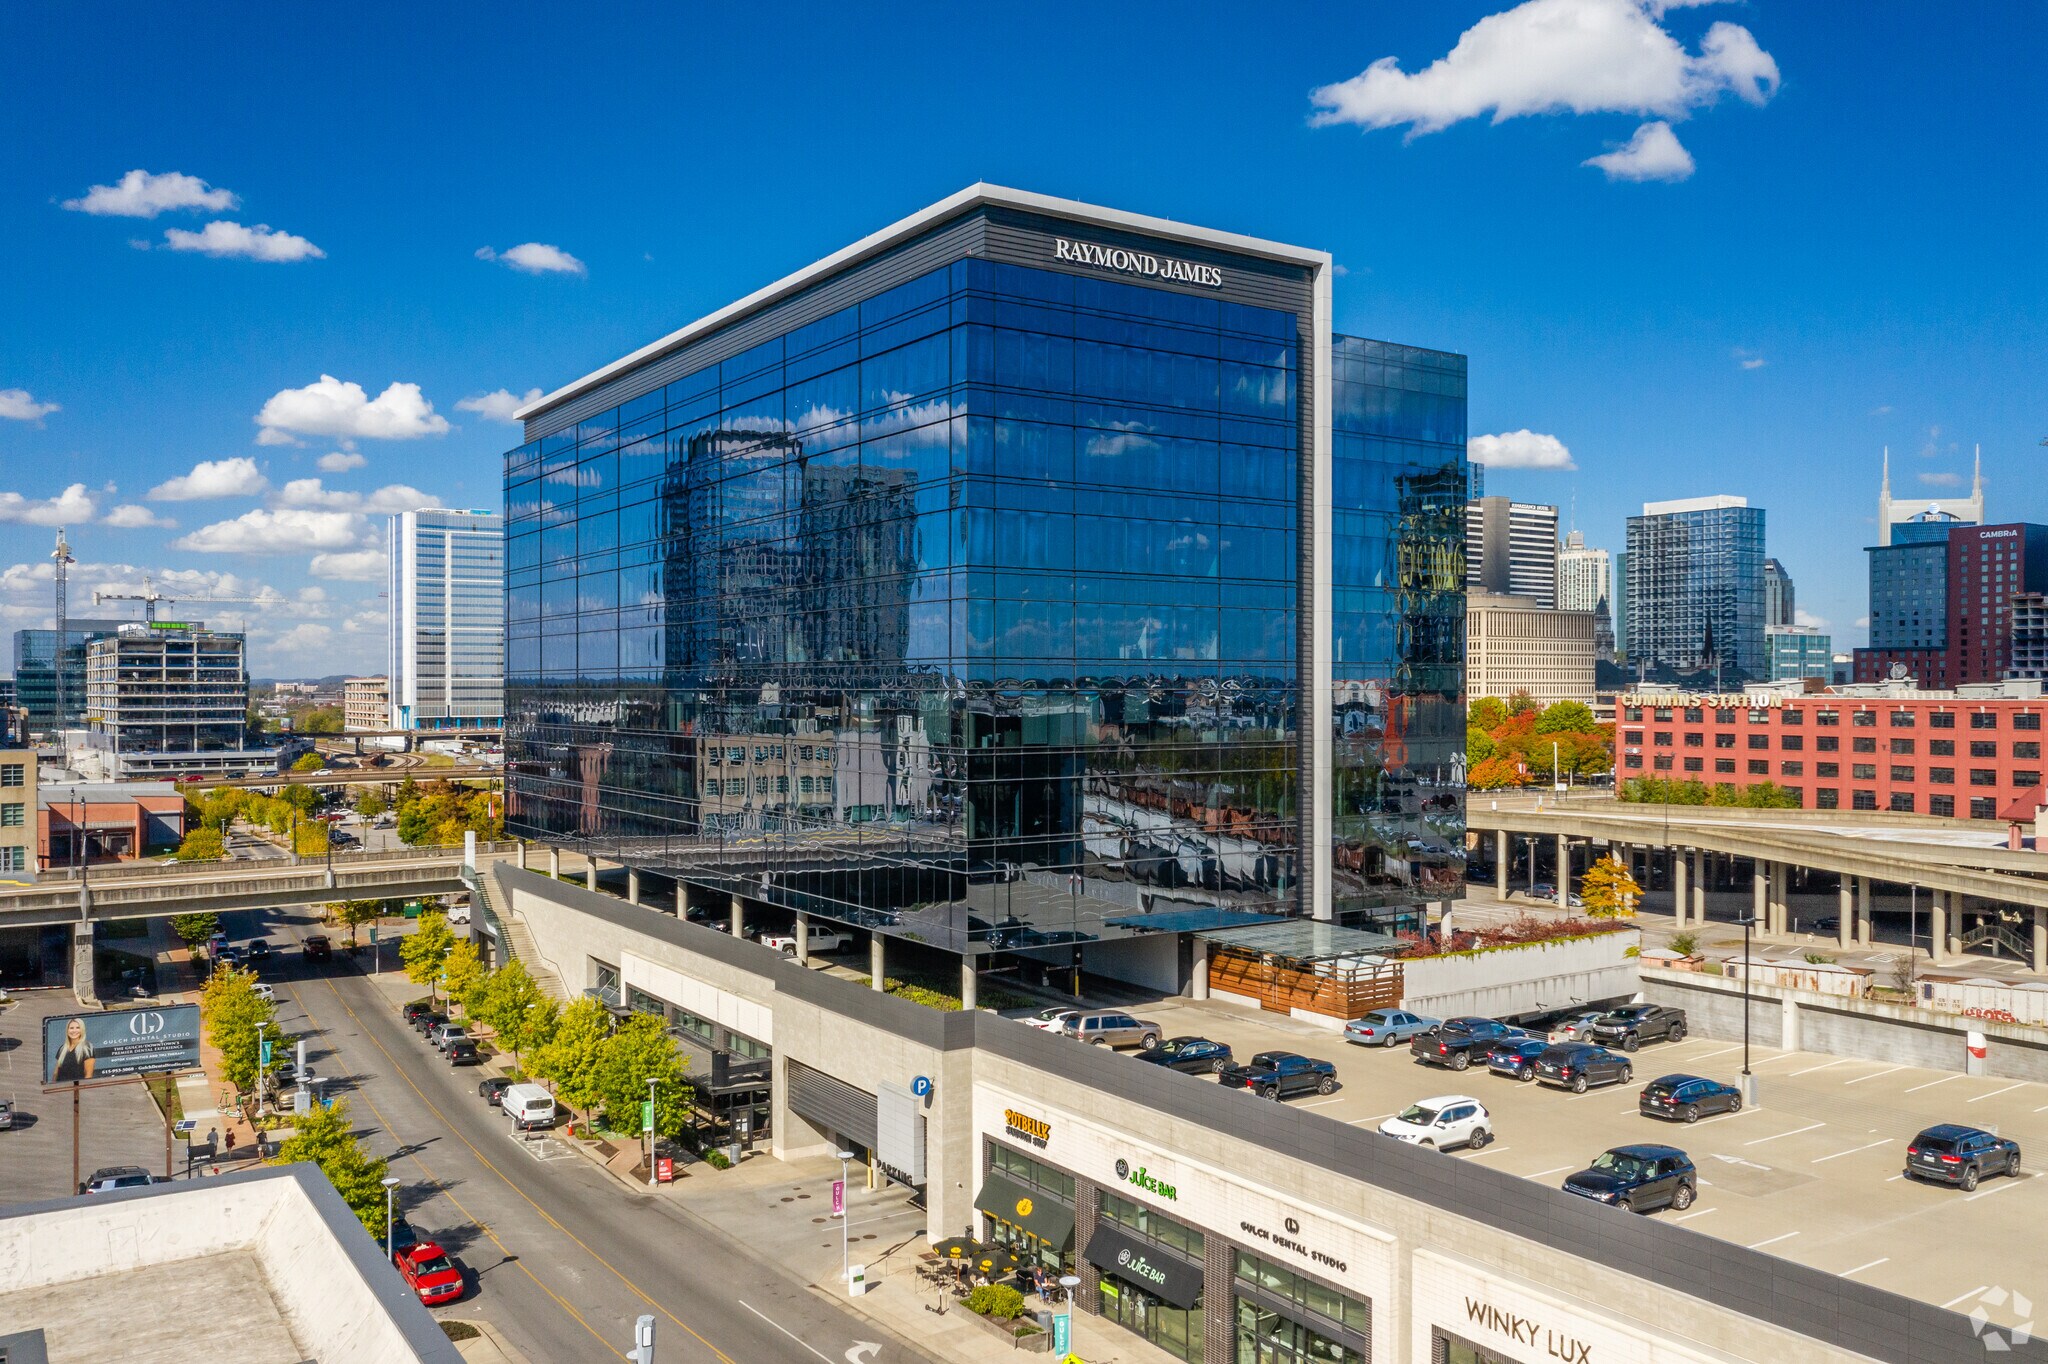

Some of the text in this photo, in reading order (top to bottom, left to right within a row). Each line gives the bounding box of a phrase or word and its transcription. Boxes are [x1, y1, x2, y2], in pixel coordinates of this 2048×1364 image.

[1054, 238, 1222, 287] RAYMOND JAMES
[1621, 693, 1783, 708] CUMMINS STATION
[103, 1031, 191, 1045] GULCH DENTAL STUDIO
[917, 1079, 927, 1094] P
[1004, 1108, 1051, 1141] POTBELLY
[877, 1159, 913, 1187] PARKING
[1129, 1167, 1157, 1193] JUICE
[1157, 1181, 1178, 1201] BAR
[1240, 1221, 1269, 1240] GULCH
[1272, 1234, 1308, 1257] DENTAL
[1311, 1251, 1347, 1273] STUDIO
[1127, 1257, 1151, 1278] JUICE
[1149, 1268, 1166, 1284] BAR
[1465, 1296, 1592, 1364] WINKY LUX
